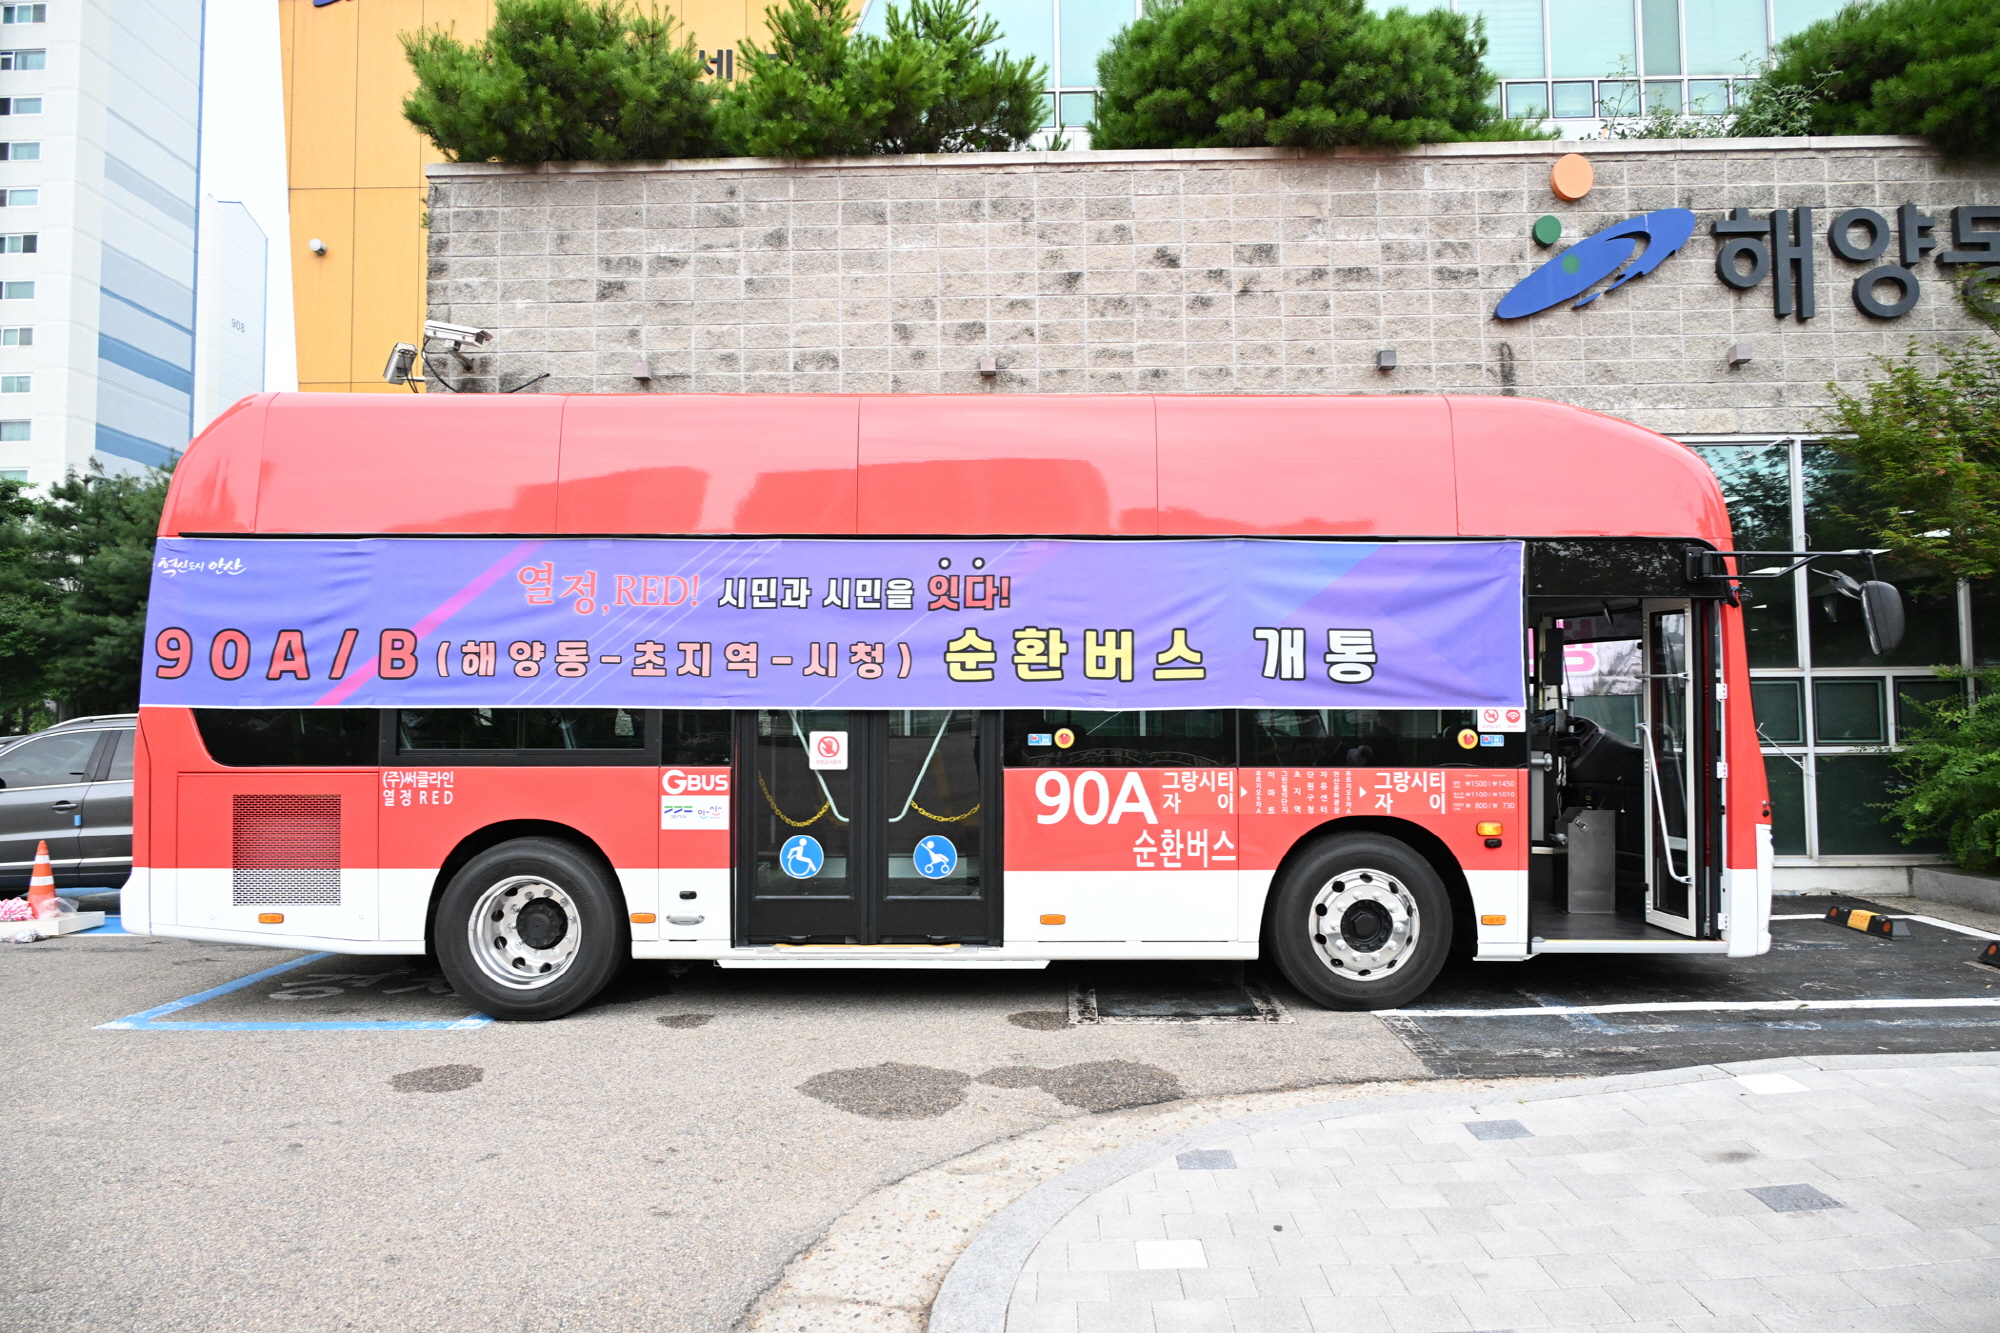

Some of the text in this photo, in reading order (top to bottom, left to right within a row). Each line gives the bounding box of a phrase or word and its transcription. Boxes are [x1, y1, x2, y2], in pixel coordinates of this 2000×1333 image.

[231, 318, 245, 333] 908
[208, 557, 247, 575] 안산
[718, 577, 811, 609] 시민과
[823, 577, 914, 610] 시민을
[927, 574, 1011, 611] 잇다!
[945, 626, 1206, 682] 순환버스
[1253, 627, 1378, 683] 개통
[382, 771, 454, 788] (주)써클라인
[662, 769, 729, 794] GBUS
[1162, 771, 1233, 793] 그랑시티
[1375, 771, 1446, 793] 그랑시티
[382, 789, 454, 807] 열정 RED
[1035, 770, 1158, 825] 90A
[1132, 829, 1236, 868] 순환버스
